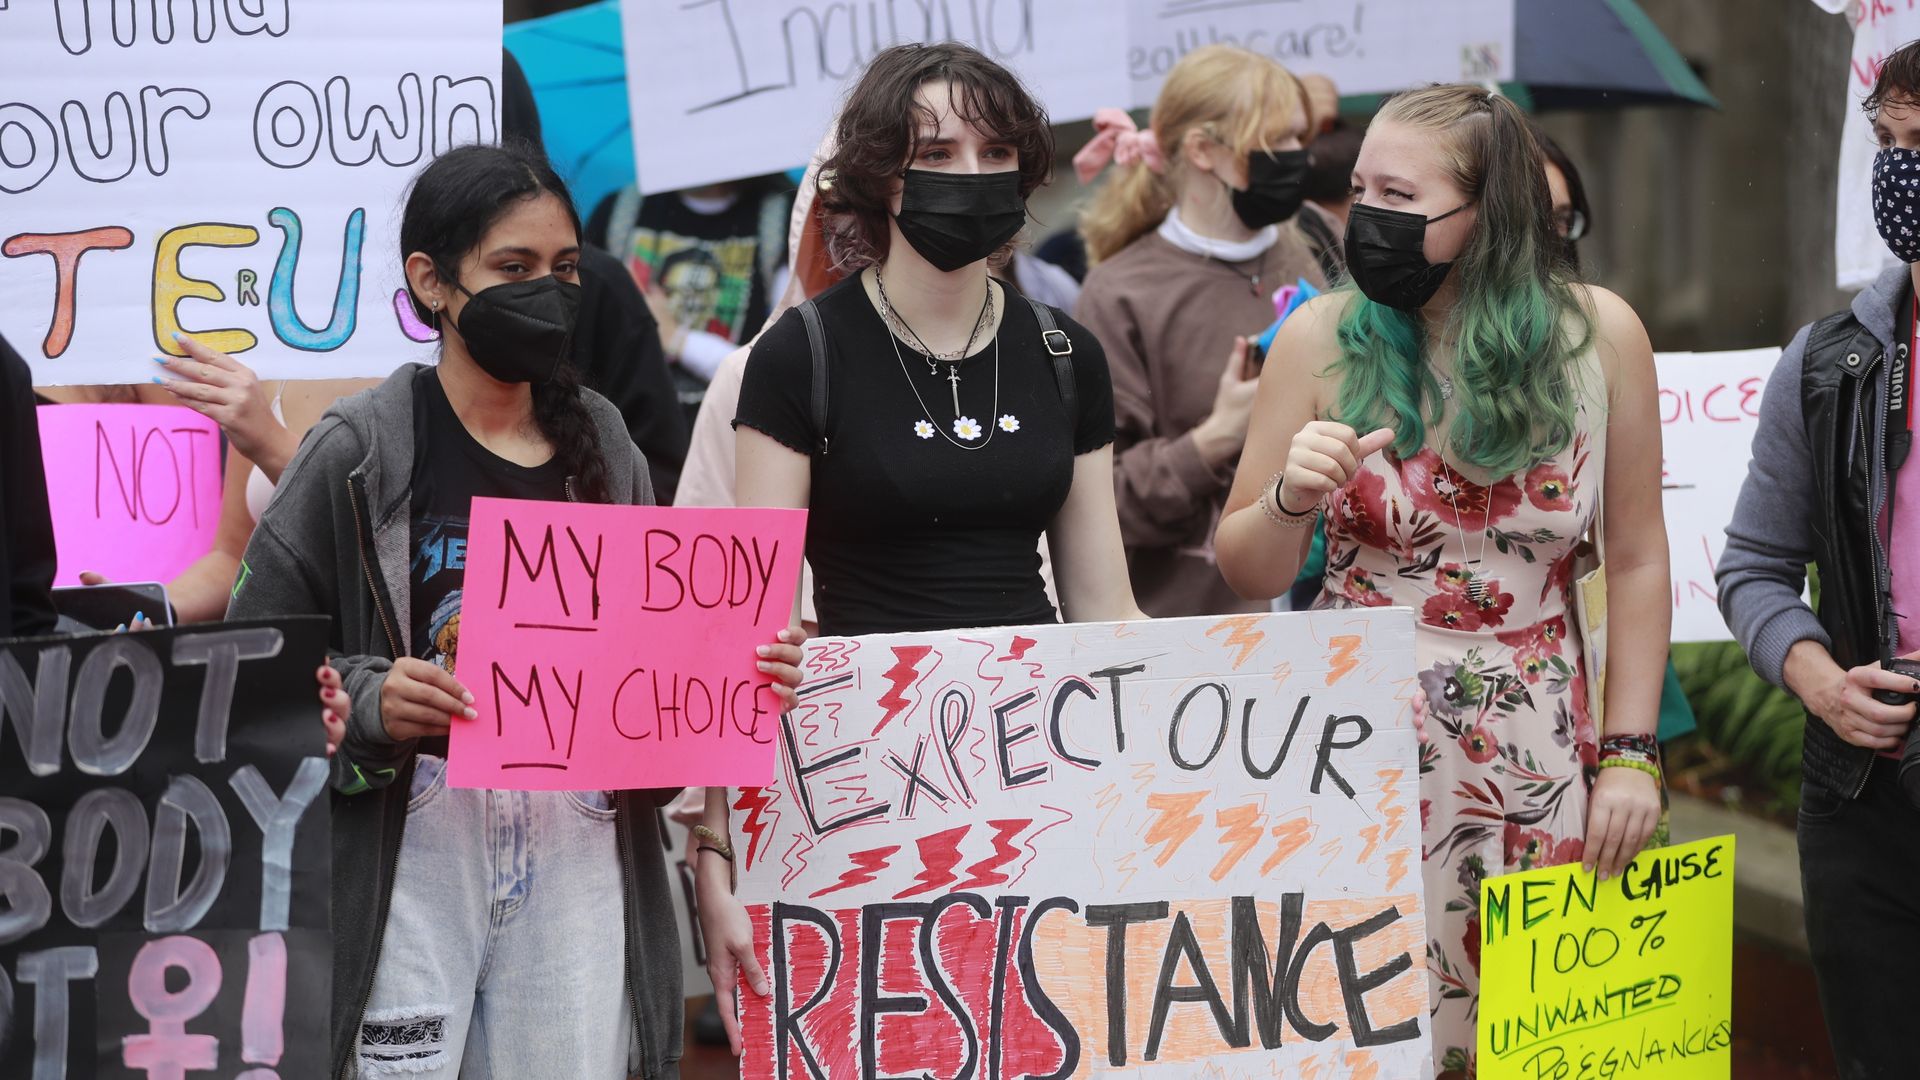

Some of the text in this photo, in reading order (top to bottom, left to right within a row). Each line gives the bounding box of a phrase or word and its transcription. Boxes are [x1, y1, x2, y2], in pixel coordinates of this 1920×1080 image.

[253, 72, 499, 168] own
[1890, 342, 1909, 411] Canon
[95, 419, 210, 530] NOT
[498, 518, 780, 626] MY BODY
[0, 627, 284, 776] NOT
[491, 661, 774, 760] MY CHOICE
[1168, 682, 1375, 800] OUR
[0, 756, 331, 945] BODY
[1486, 845, 1723, 946] MEN CAUSE
[772, 891, 1422, 1080] RESISTANCE
[1489, 974, 1682, 1056] UNWANTED
